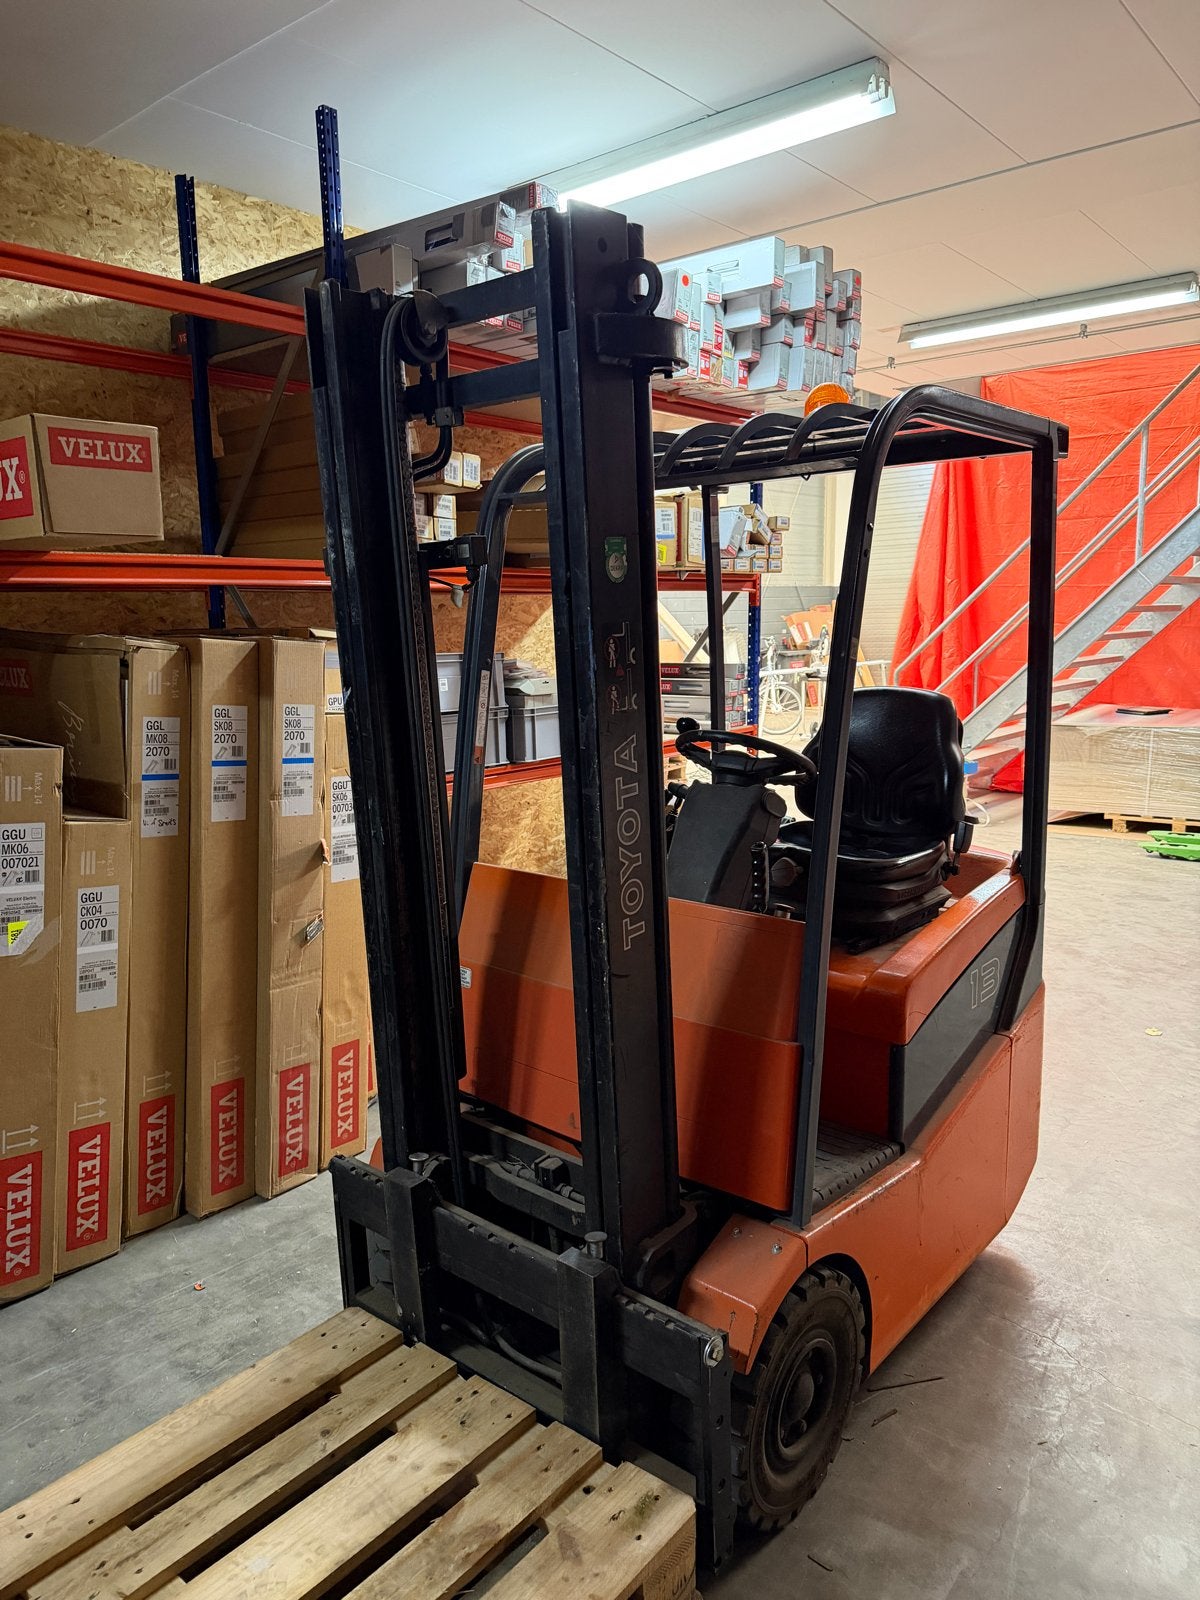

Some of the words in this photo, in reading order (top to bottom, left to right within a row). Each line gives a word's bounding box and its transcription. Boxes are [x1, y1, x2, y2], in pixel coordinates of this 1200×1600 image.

[328, 697, 343, 706] GPU
[214, 708, 232, 719] GGL
[284, 706, 301, 716] GGL
[146, 720, 165, 731] GGL
[213, 721, 233, 731] SK08
[283, 719, 302, 729] SK08
[145, 733, 168, 744] MK08
[213, 733, 237, 744] 2070
[283, 731, 305, 741] 2070
[145, 746, 170, 757] 2070
[332, 780, 348, 790] GGU
[2, 828, 26, 841] GGU
[614, 734, 646, 951] TOYOTA
[1, 843, 29, 855] MK06
[1, 856, 39, 869] 007021
[80, 891, 103, 904] GGU
[80, 905, 102, 917] CK04
[80, 917, 108, 931] 0070
[970, 957, 1000, 1009] 13
